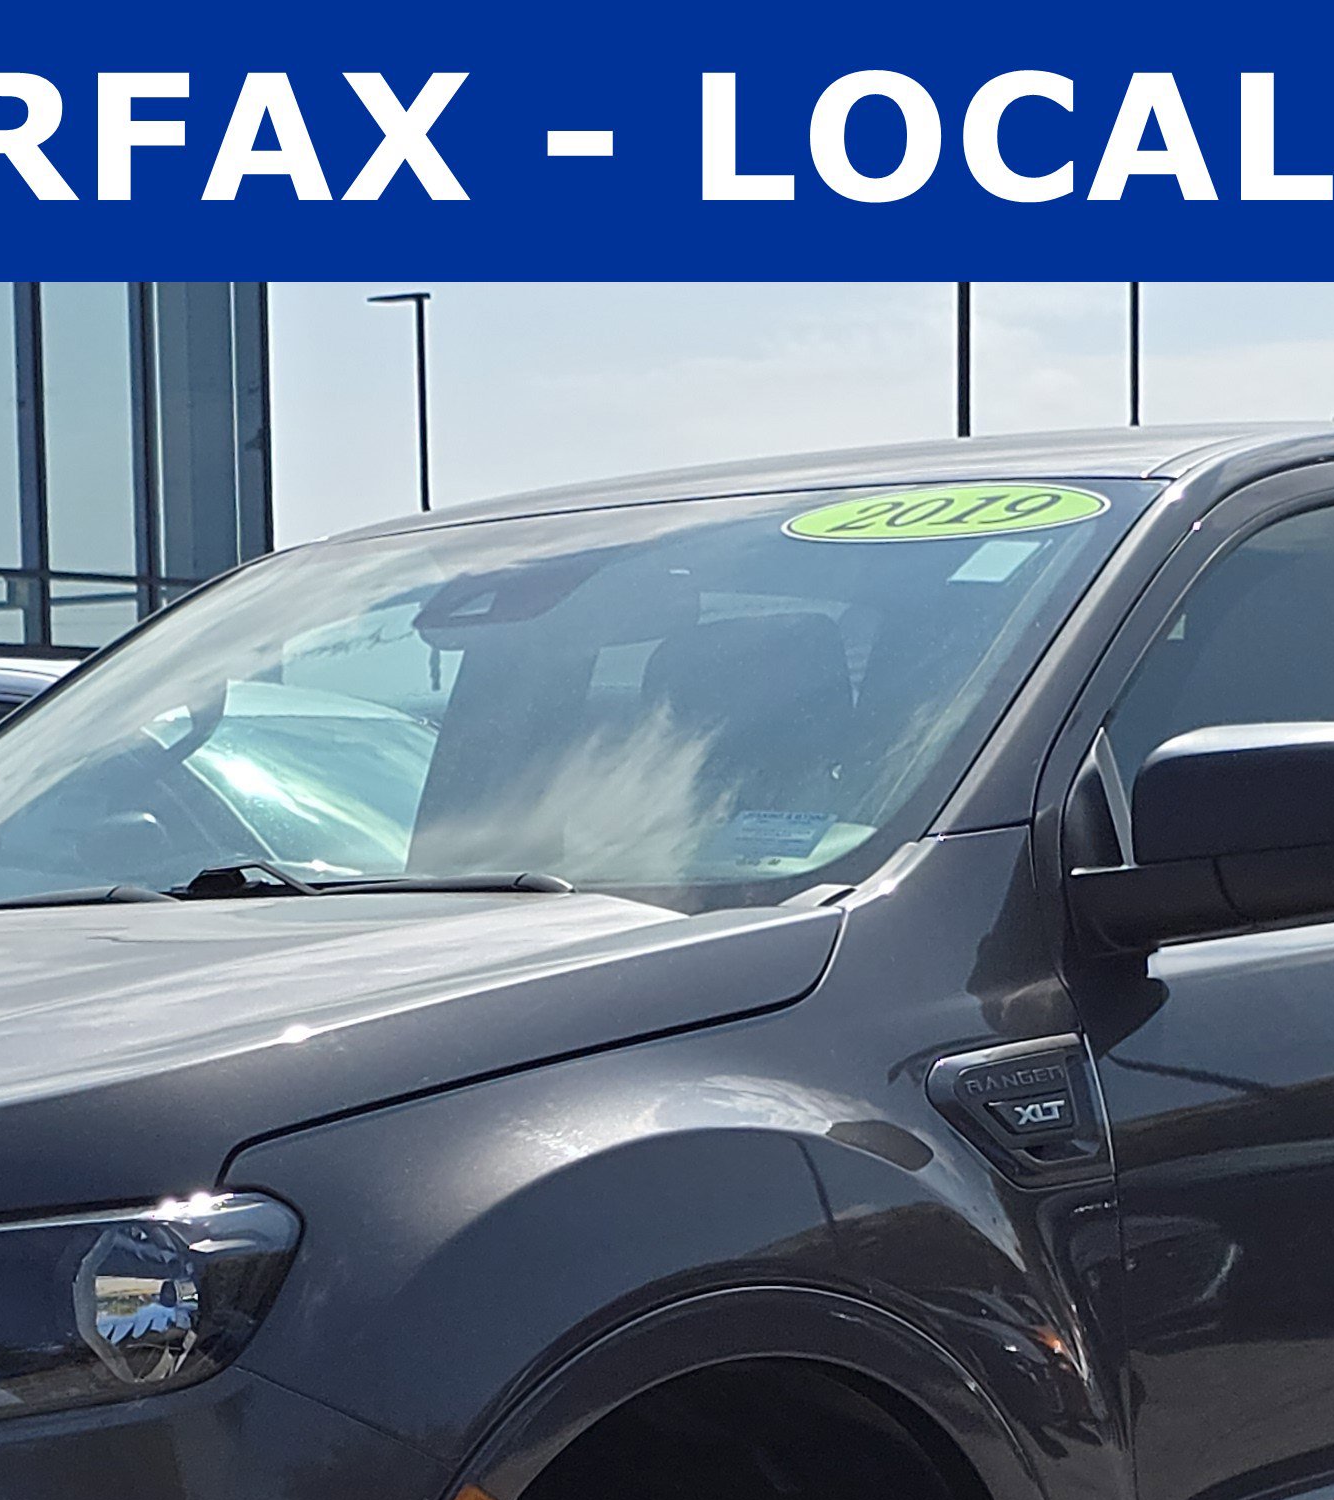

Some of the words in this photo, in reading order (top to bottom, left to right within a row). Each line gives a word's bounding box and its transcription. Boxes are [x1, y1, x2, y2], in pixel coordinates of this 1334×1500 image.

[825, 493, 1062, 533] 2019
[965, 1065, 1065, 1094] RANGER
[1014, 1100, 1065, 1125] XLT
